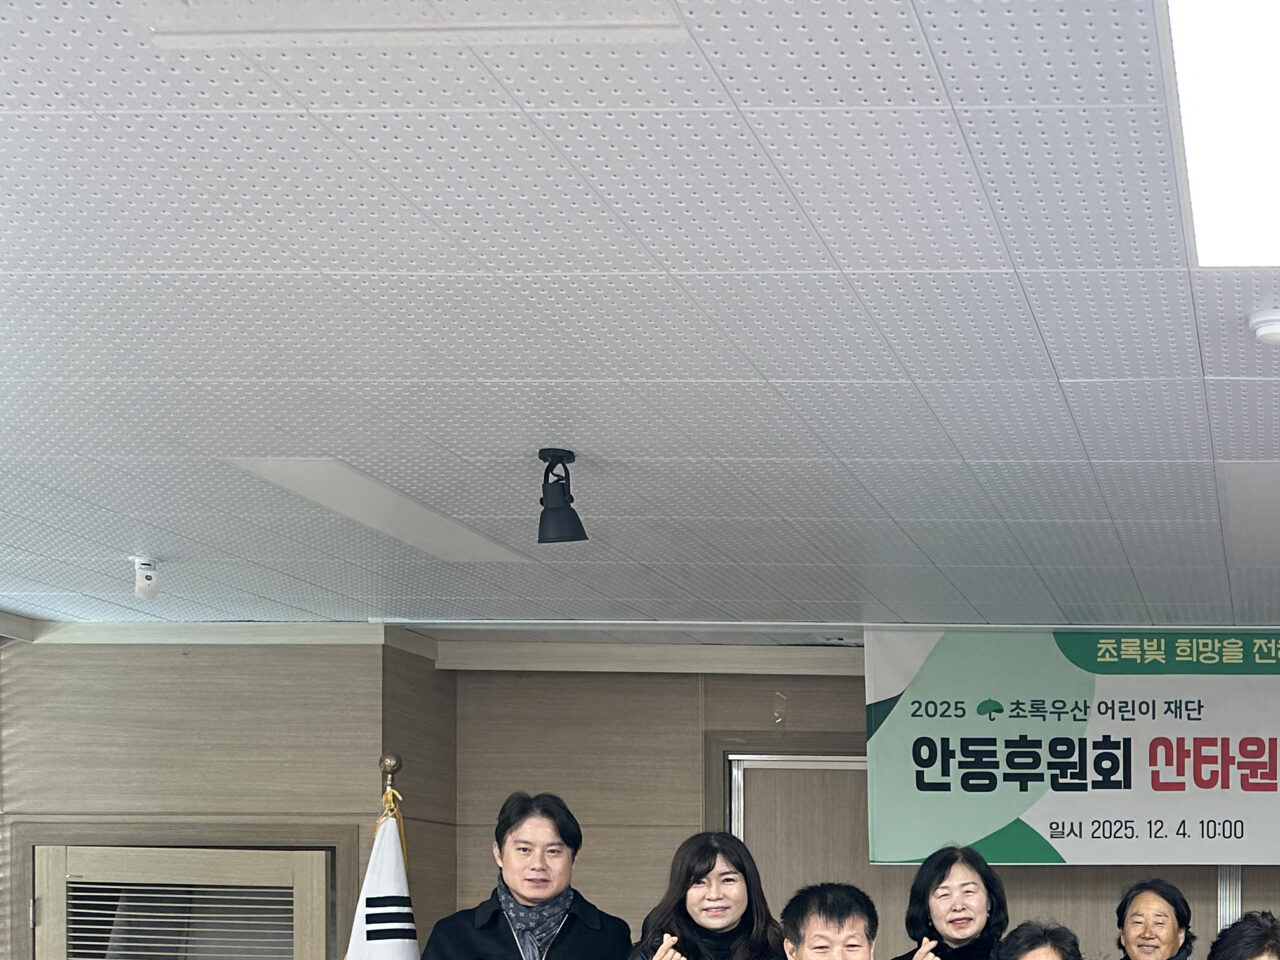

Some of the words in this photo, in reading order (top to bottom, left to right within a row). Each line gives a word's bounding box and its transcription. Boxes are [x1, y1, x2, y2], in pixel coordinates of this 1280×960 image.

[1097, 638, 1166, 664] 초록빛
[1175, 638, 1244, 664] 희망을
[910, 700, 966, 718] 2025
[1008, 699, 1090, 722] 초록우산
[1097, 699, 1156, 721] 어린이
[1163, 699, 1204, 721] 재단
[912, 734, 1132, 793] 안동후원회
[1048, 821, 1083, 839] 일시
[1091, 820, 1139, 839] 2025.
[1147, 820, 1168, 839] 12.
[1175, 820, 1191, 839] 4.
[1199, 820, 1245, 839] 10:00
